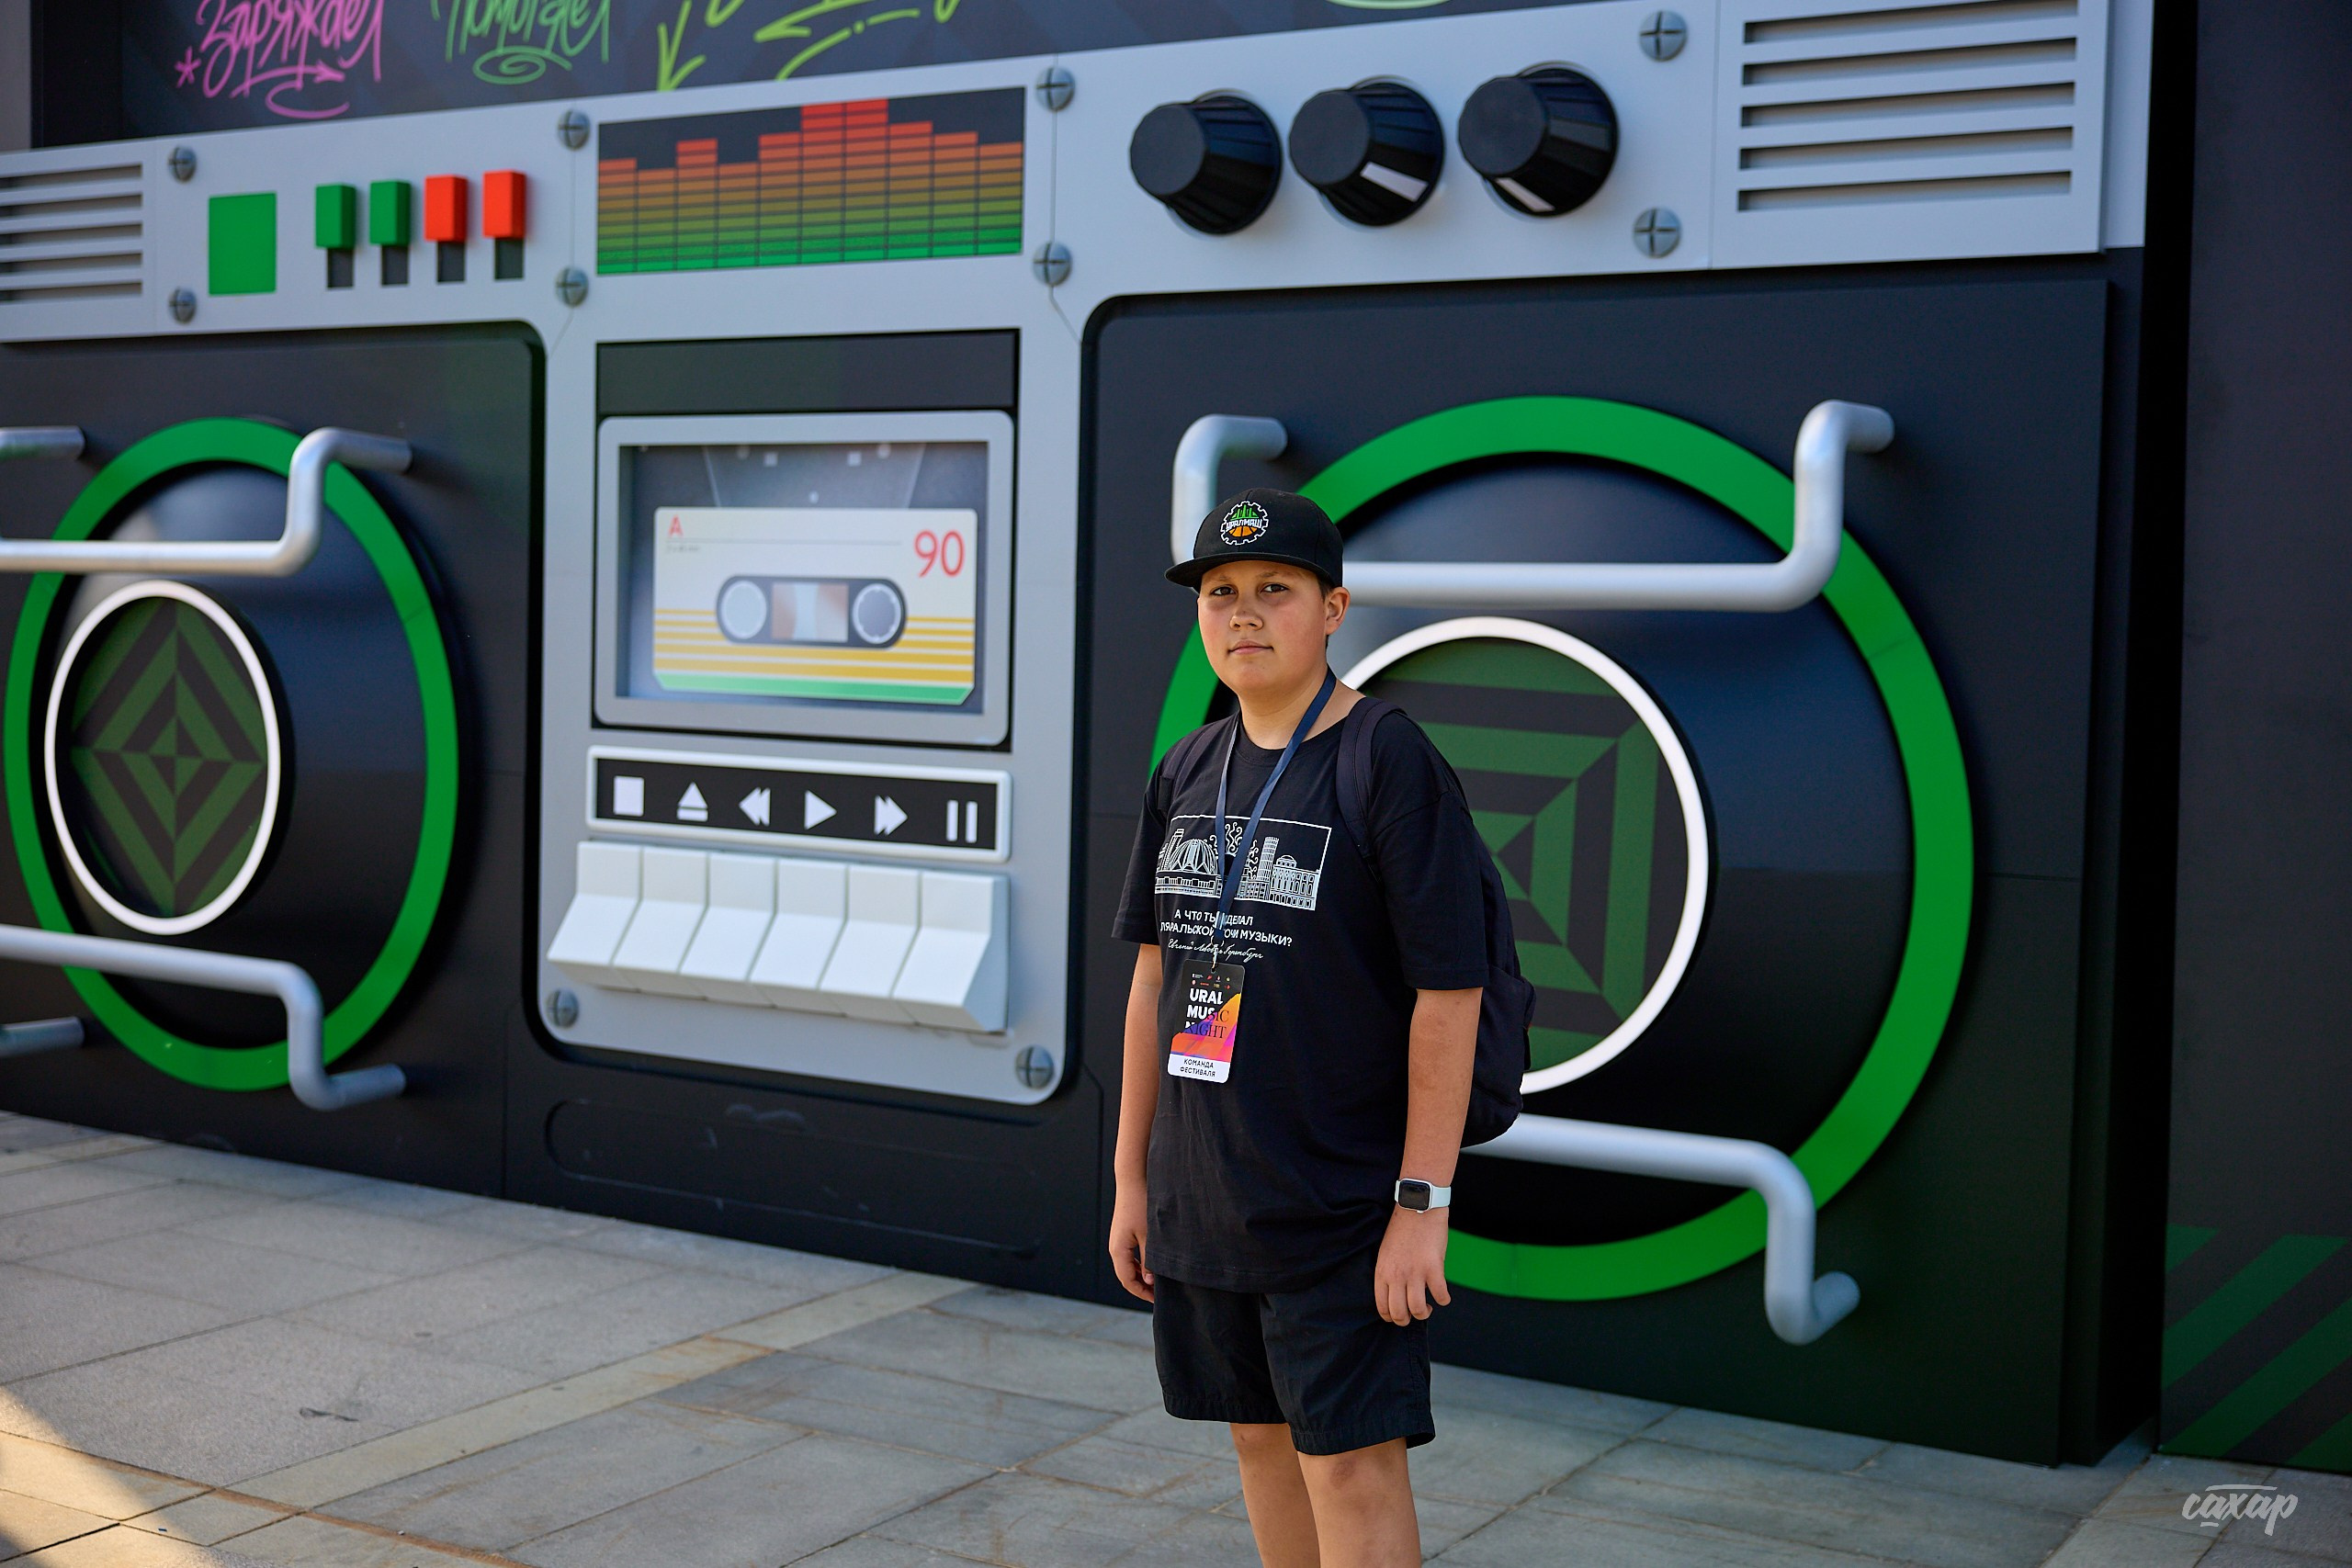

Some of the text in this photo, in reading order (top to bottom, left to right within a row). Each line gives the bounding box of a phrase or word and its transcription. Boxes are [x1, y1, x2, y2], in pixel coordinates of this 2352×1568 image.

[913, 529, 966, 578] 90
[1184, 909, 1203, 921] ЧТО
[1223, 914, 1254, 927] ДЕЛАЛ
[1223, 928, 1239, 939] ОЧИ
[1239, 929, 1293, 947] МУЗЫКИ?
[1189, 987, 1224, 1005] URAL
[1186, 1004, 1229, 1022] MUSIC
[1184, 1021, 1227, 1039] NIGHT
[1180, 1066, 1216, 1077] ФЕСТИВАЛЯ
[1183, 1058, 1214, 1069] КОМАНДА
